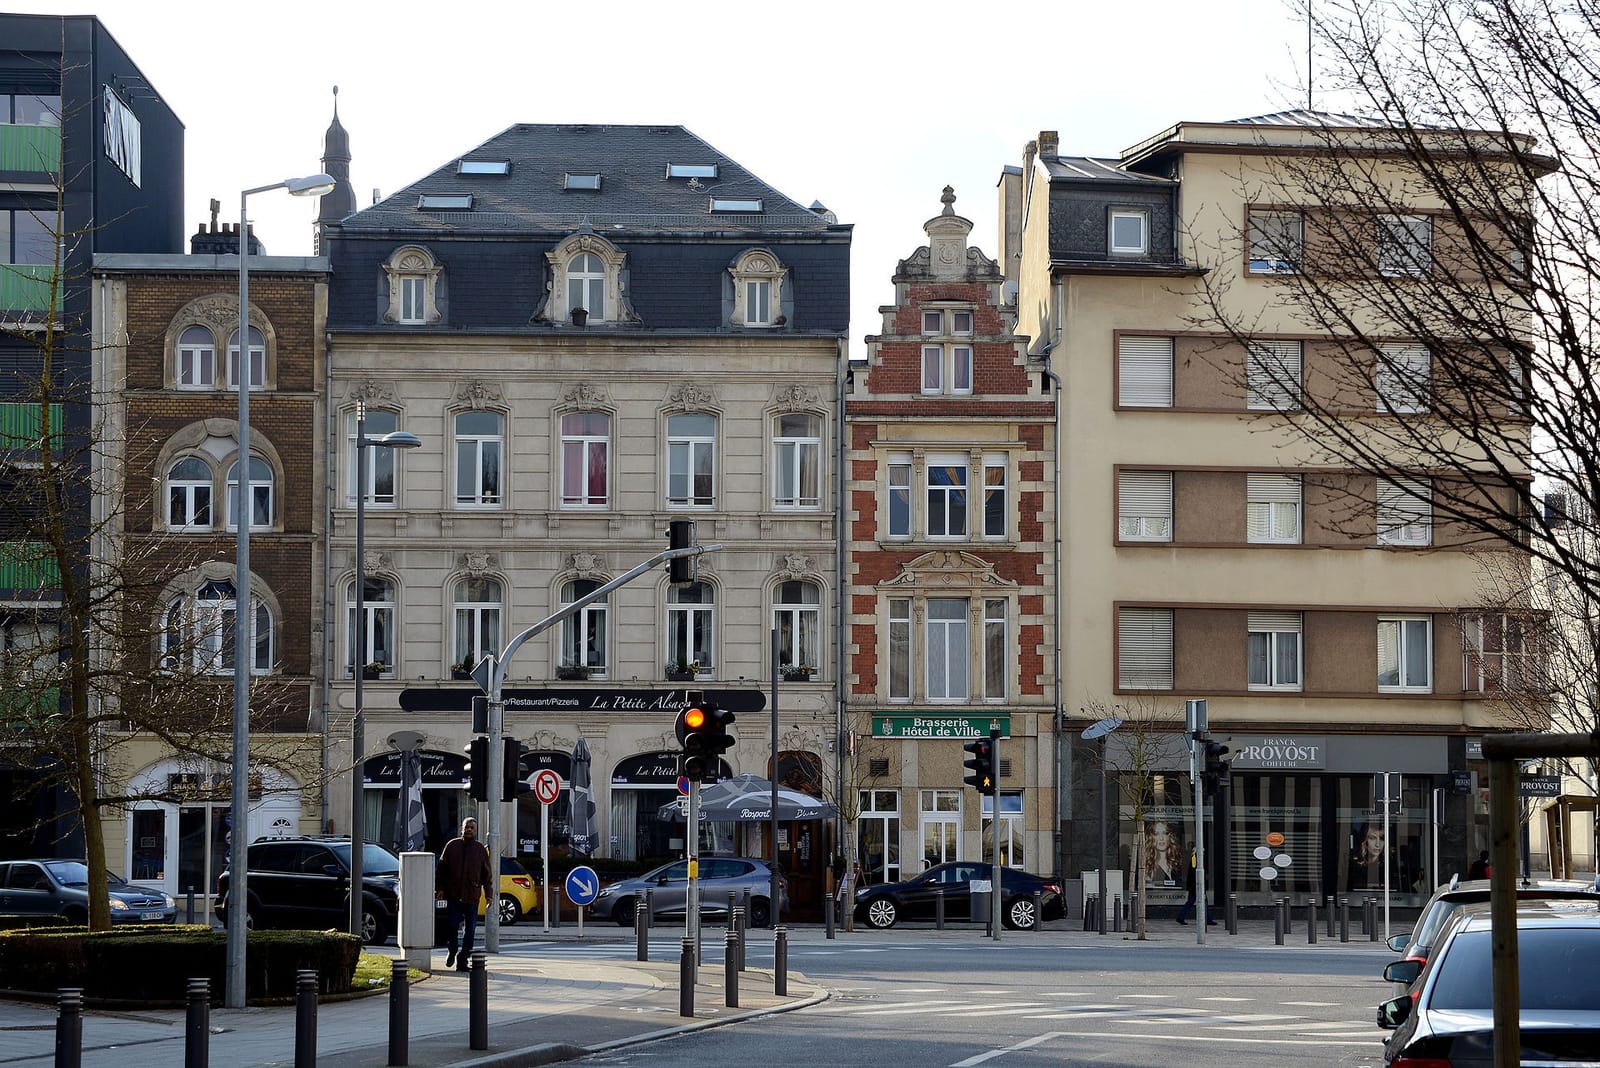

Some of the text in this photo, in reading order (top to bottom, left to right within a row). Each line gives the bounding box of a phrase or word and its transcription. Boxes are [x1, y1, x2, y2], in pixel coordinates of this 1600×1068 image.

[503, 697, 579, 707] e/Restaurant/Pizzeria
[590, 695, 609, 709] La
[612, 695, 646, 709] Petite
[914, 717, 969, 727] Brasserie
[902, 726, 981, 736] Hôtel de Ville
[1263, 738, 1296, 746] FRANCK
[1239, 745, 1319, 761] PROVOST
[380, 765, 394, 776] La
[423, 762, 455, 777] Alsace
[635, 766, 649, 776] La
[1521, 782, 1560, 790] PROVOST
[740, 808, 771, 820] Rosport
